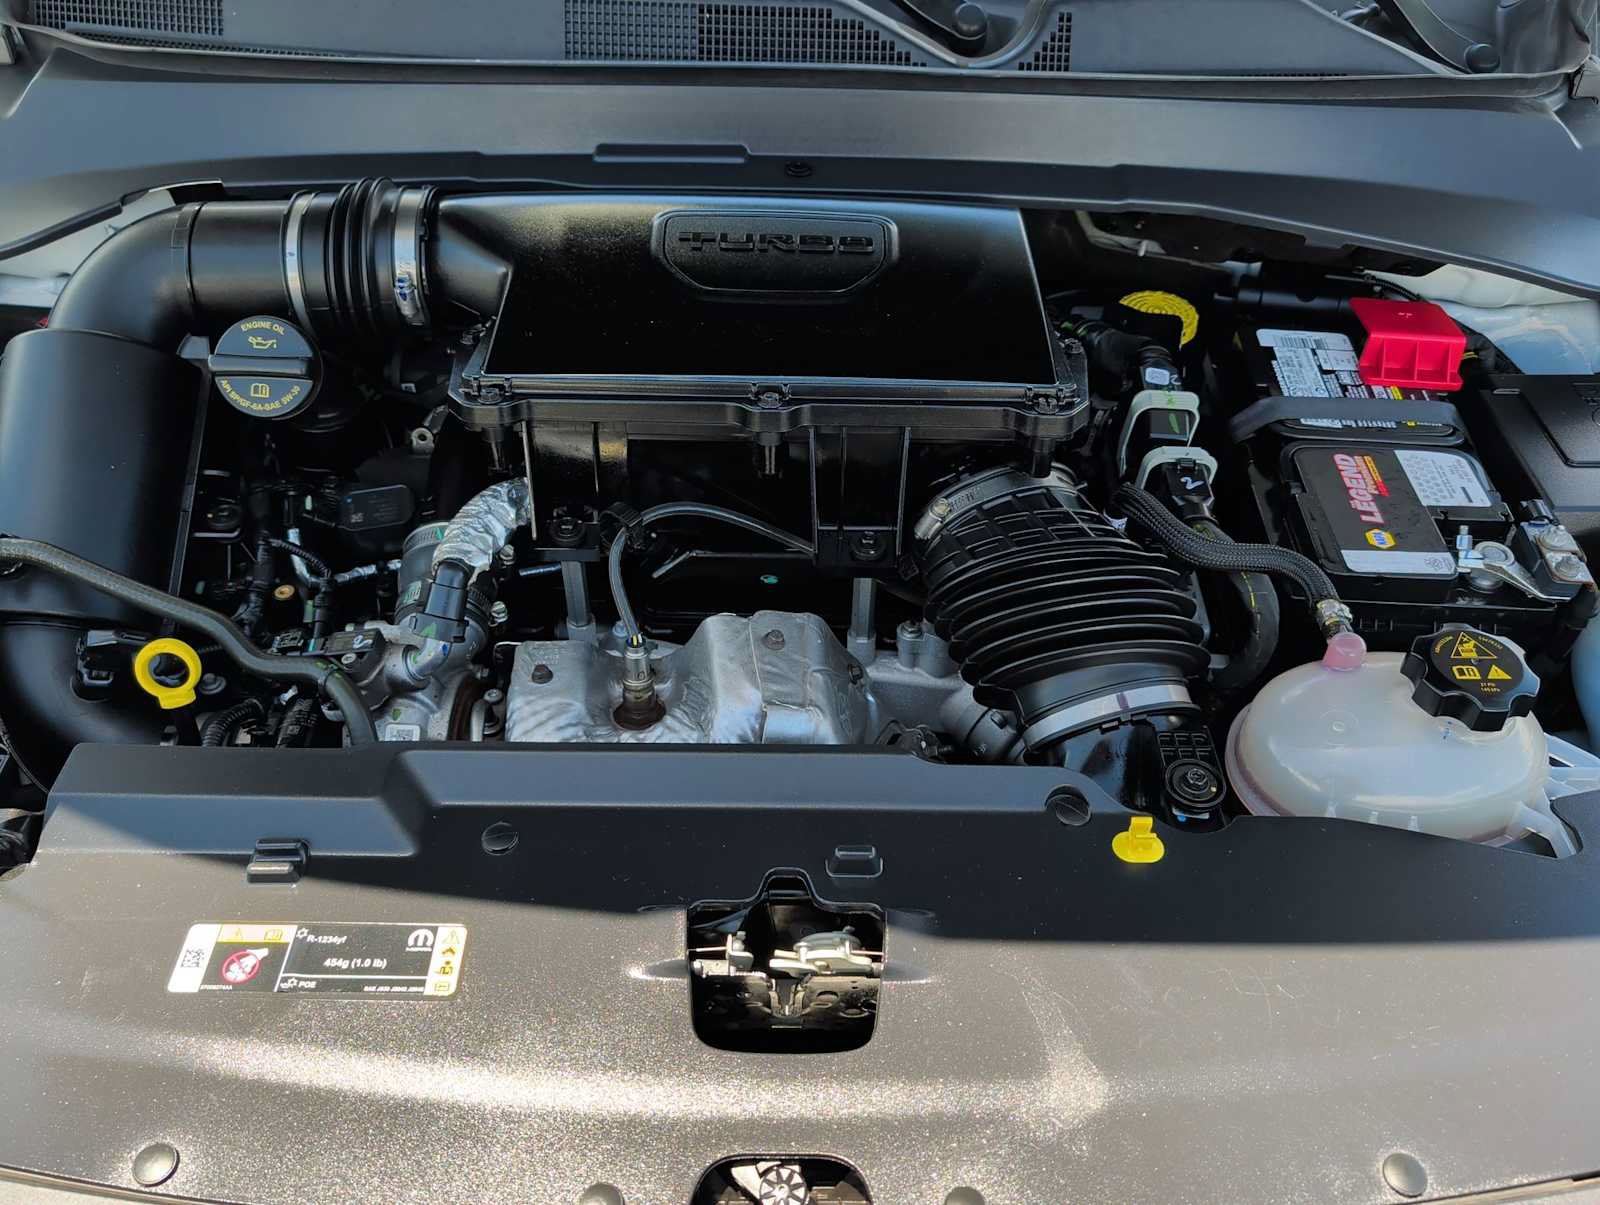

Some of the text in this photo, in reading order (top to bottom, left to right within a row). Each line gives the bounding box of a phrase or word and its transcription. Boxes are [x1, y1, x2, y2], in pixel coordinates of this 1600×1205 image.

[678, 231, 875, 252] TURBO
[241, 321, 285, 335] ENGINE OIL
[323, 957, 388, 970] 454g (1.0 lb)
[298, 980, 317, 989] POE
